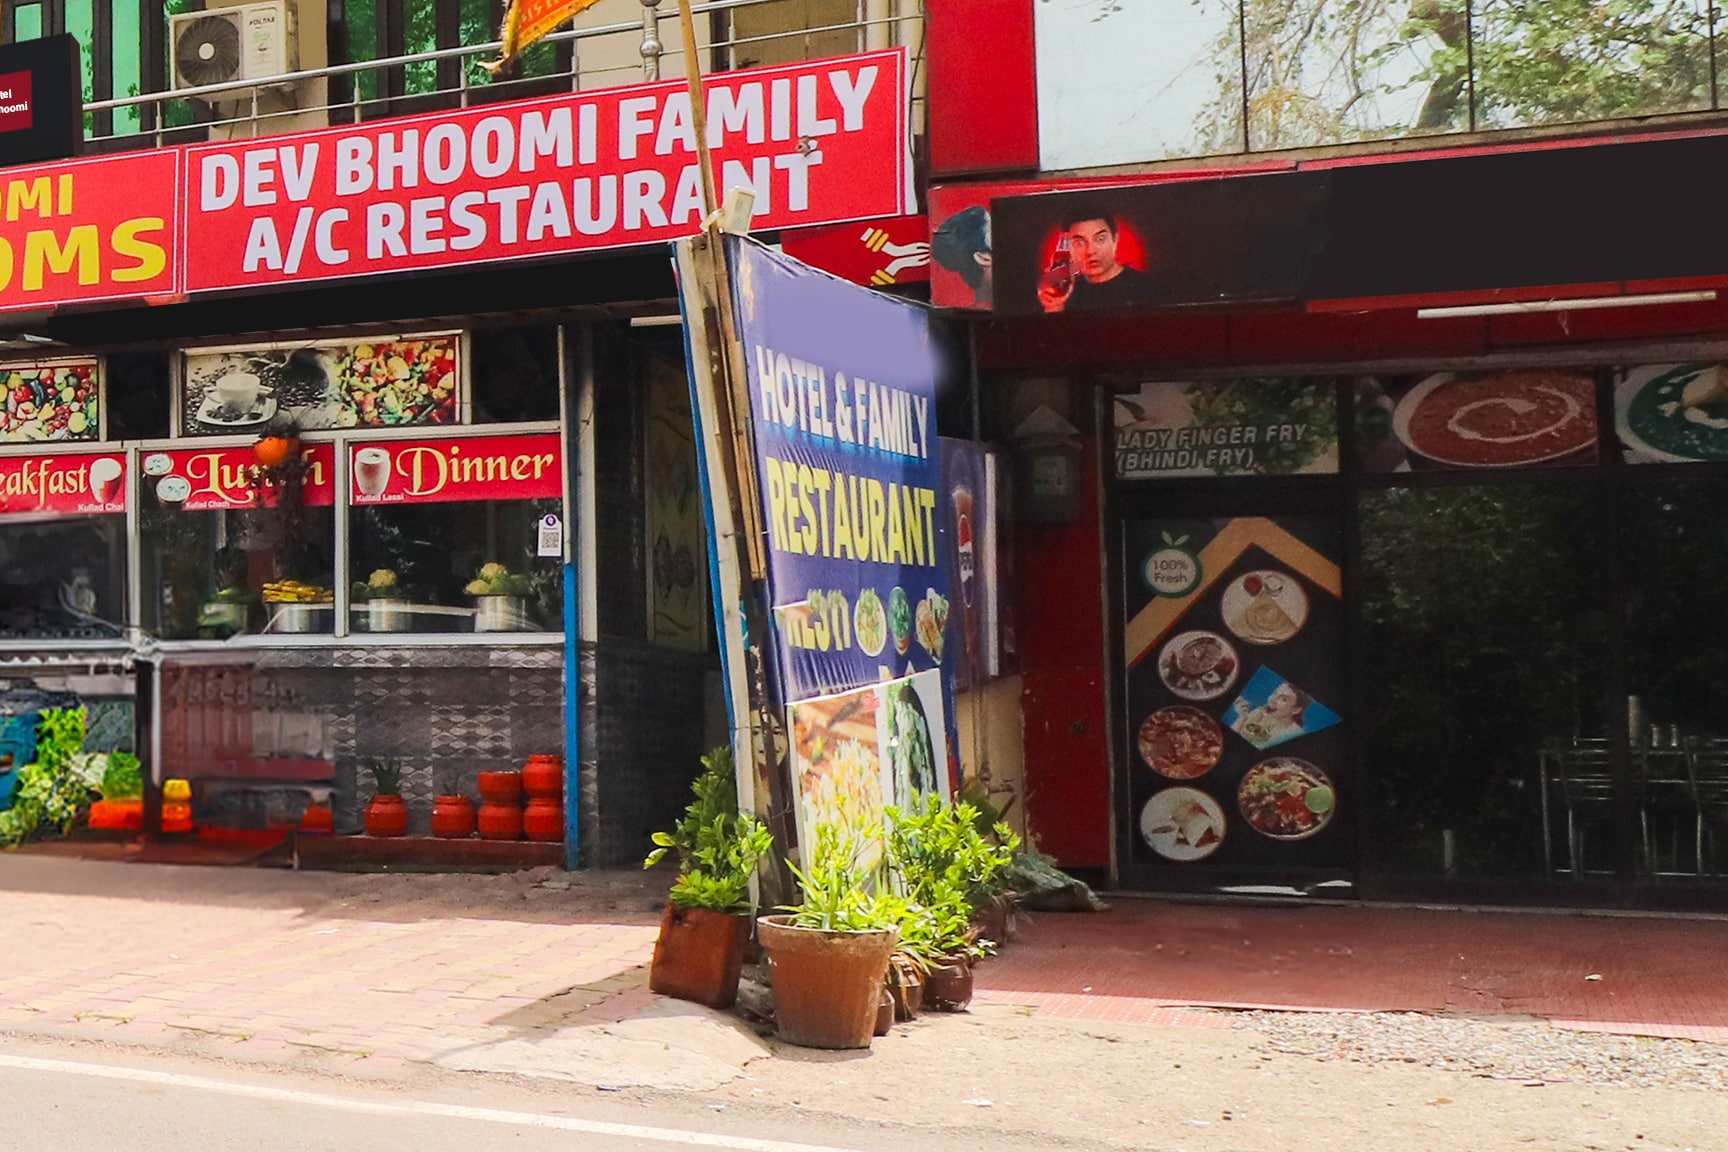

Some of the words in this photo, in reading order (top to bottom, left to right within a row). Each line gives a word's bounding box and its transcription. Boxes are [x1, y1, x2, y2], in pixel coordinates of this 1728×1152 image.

[200, 143, 319, 211] DEV
[335, 103, 599, 197] BHOOMI
[618, 65, 879, 160] FAMILY
[242, 206, 349, 275] A/C
[366, 149, 824, 261] RESTAURANT
[755, 344, 833, 439] HOTEL
[834, 370, 854, 444] &
[853, 376, 928, 459] FAMILY
[1116, 450, 1198, 475] (BHINDI
[1206, 448, 1255, 467] FRY)
[1117, 430, 1171, 449] LADY
[1177, 425, 1257, 447] FINGER
[1265, 423, 1307, 443] FRY
[186, 448, 326, 504] Luh
[395, 445, 555, 496] Dinner
[765, 456, 935, 567] RESTAURANT
[1153, 559, 1189, 571] 100%
[1153, 572, 1188, 584] Fresh
